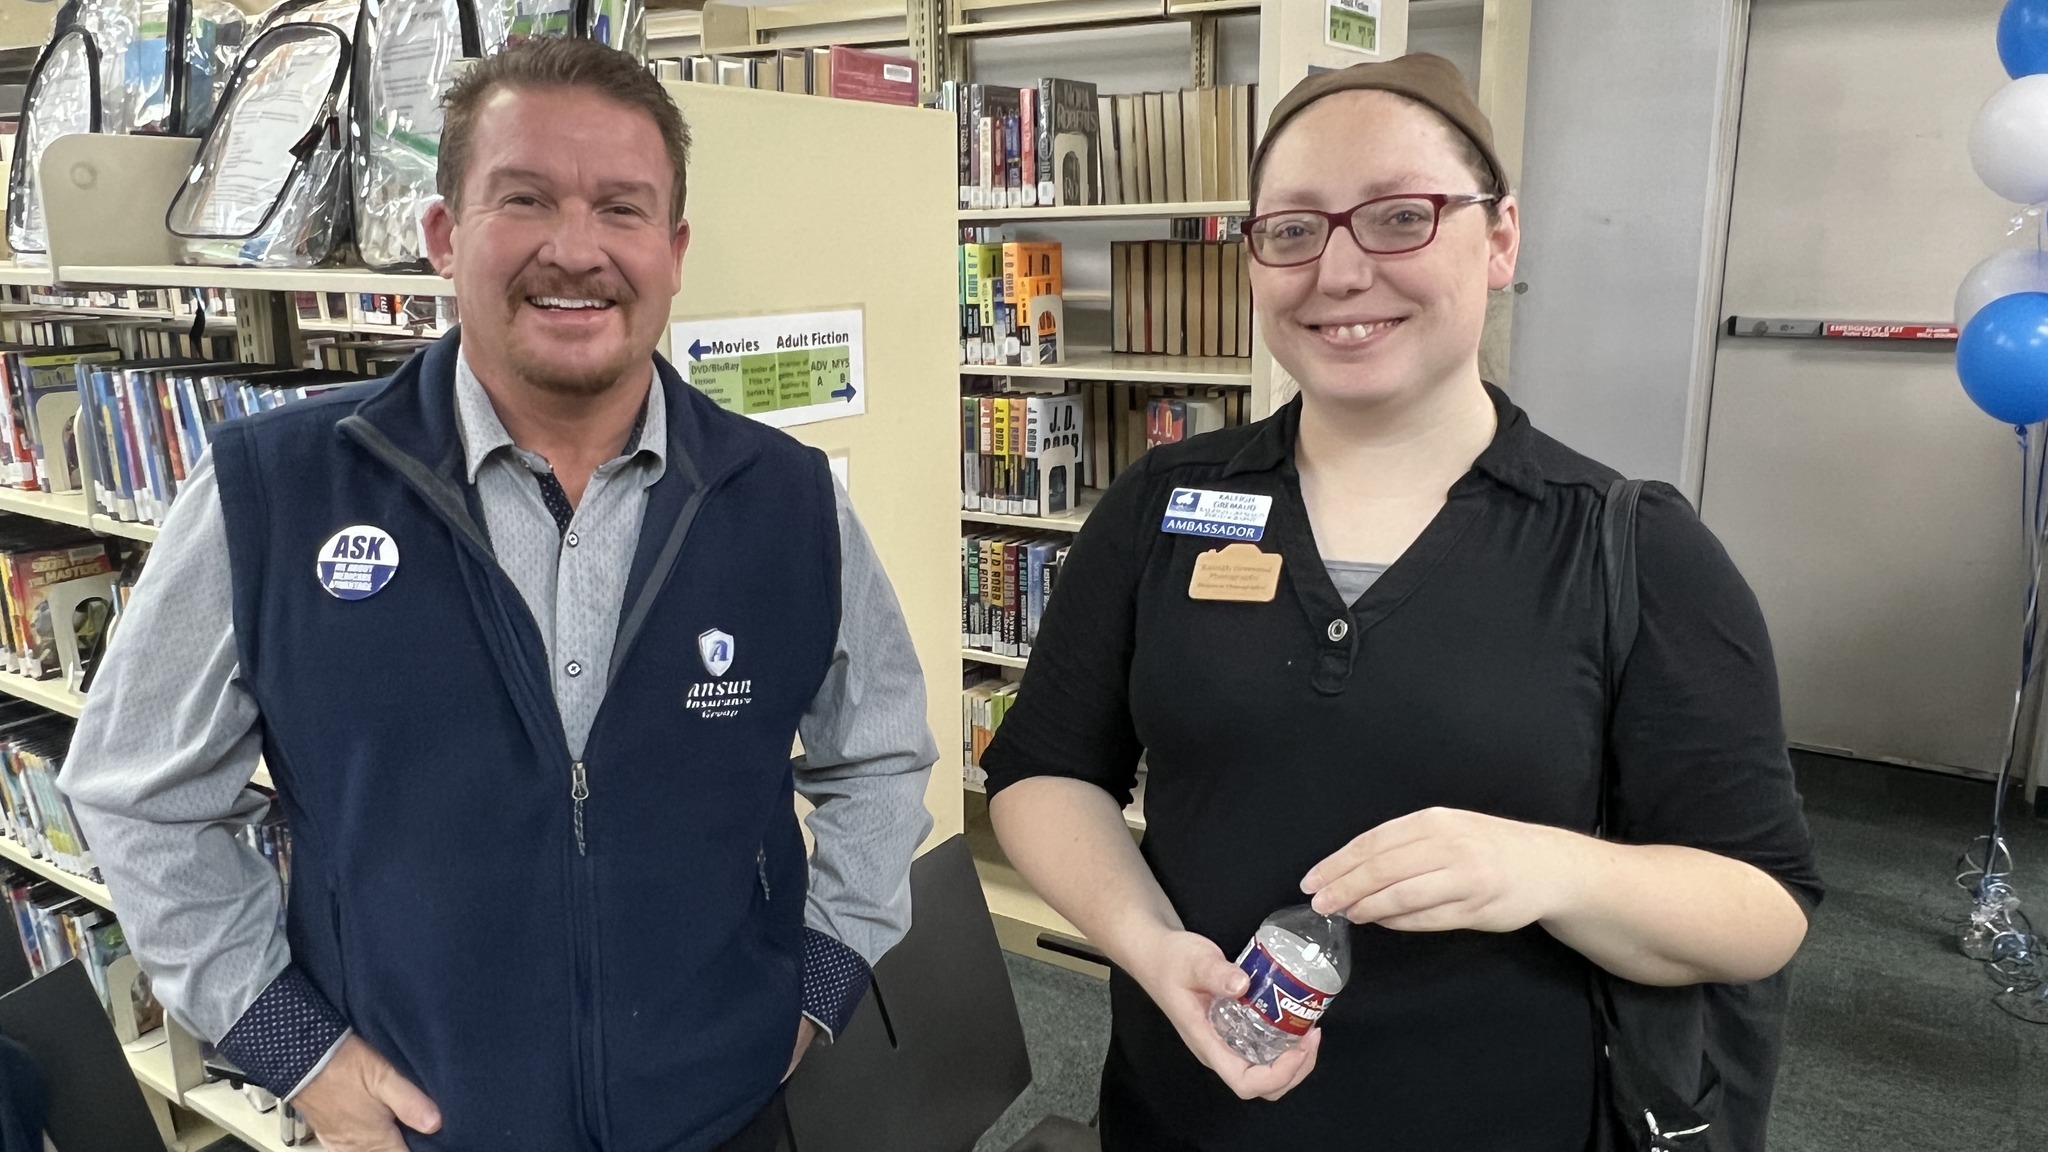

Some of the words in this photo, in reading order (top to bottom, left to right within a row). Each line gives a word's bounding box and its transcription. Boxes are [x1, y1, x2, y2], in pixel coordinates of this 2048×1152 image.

[712, 338, 760, 355] Movies
[776, 333, 808, 349] Adult
[812, 331, 849, 347] Fiction
[691, 363, 739, 375] DVD/BluRay
[811, 361, 828, 372] ADV
[832, 359, 850, 370] MYS
[817, 376, 823, 386] A
[840, 373, 846, 383] B
[1167, 519, 1255, 538] AMBASSADOR
[332, 535, 386, 560] ASK
[991, 570, 1000, 601] ROBB
[709, 640, 729, 662] A
[686, 697, 752, 709] Insurance
[702, 709, 739, 719] Group
